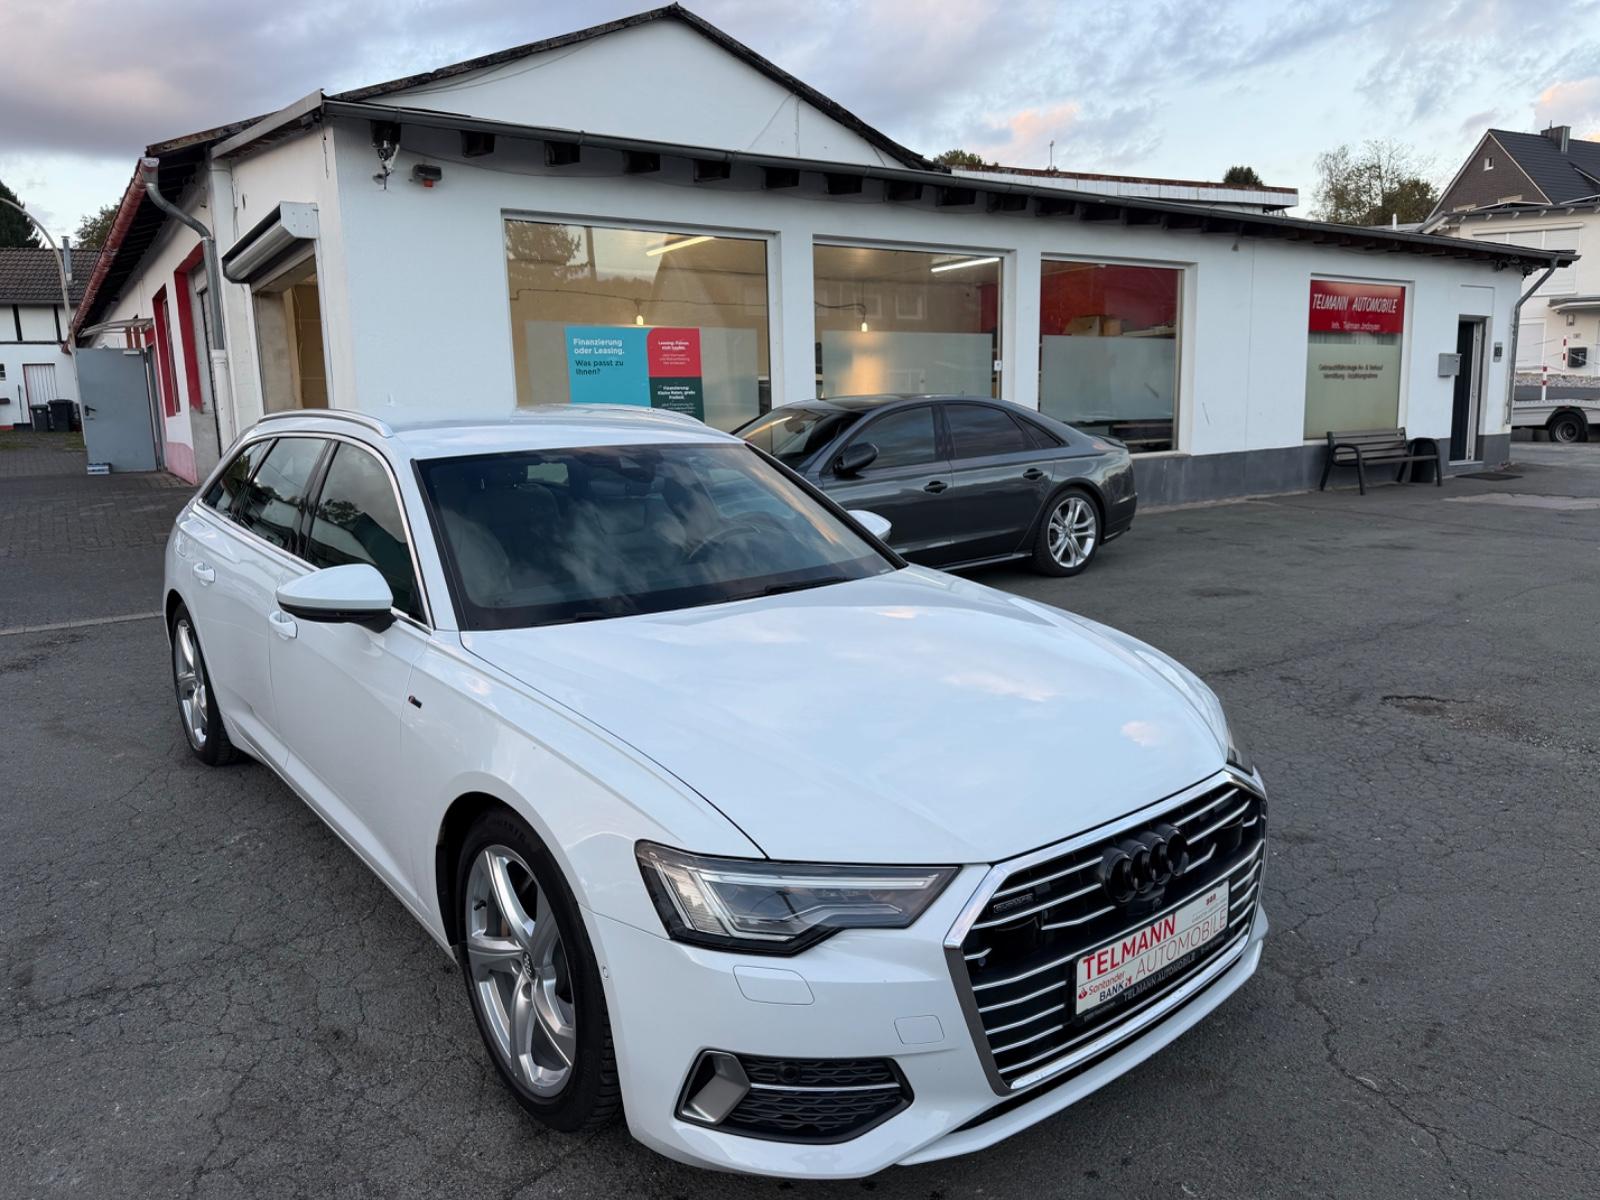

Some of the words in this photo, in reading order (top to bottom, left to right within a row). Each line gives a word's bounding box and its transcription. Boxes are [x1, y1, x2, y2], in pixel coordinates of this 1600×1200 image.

[1312, 294, 1349, 311] TELMANN
[1351, 297, 1398, 313] AUTOMOBILE
[573, 338, 622, 346] Finanzierung
[574, 347, 592, 355] oder
[594, 347, 625, 356] Leasing.
[576, 368, 601, 376] Ihnen?
[593, 360, 613, 368] passt
[1083, 912, 1176, 980] TELMANN
[1135, 907, 1227, 979] AUTOMOBILE
[1088, 971, 1125, 996] Santander
[1099, 981, 1126, 1002] BANK
